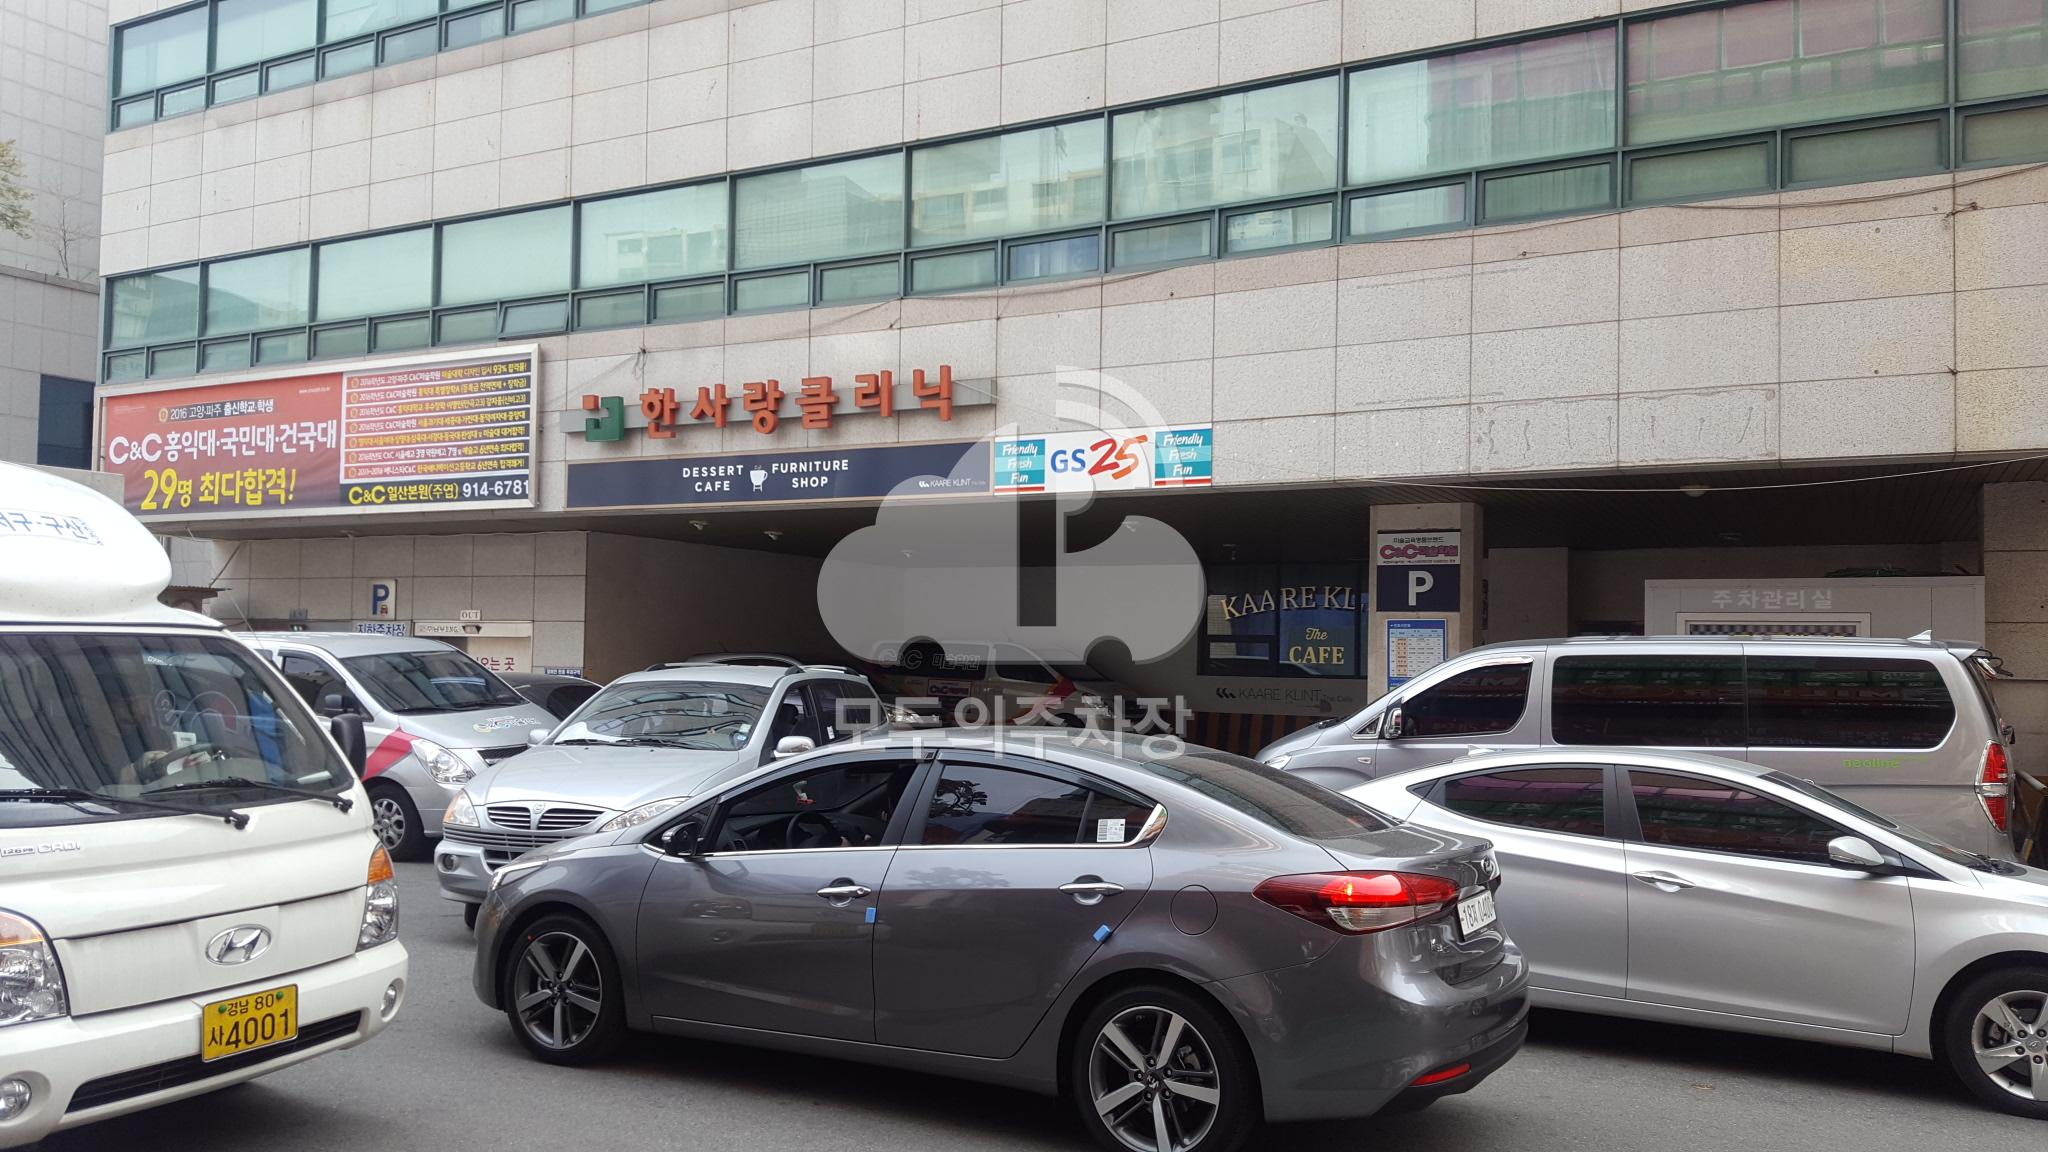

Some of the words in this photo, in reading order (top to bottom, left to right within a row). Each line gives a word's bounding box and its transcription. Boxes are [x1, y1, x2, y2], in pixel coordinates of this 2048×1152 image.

[639, 364, 953, 440] 한사랑클리닉
[169, 408, 188, 420] 2016
[1163, 433, 1204, 446] Friendly
[109, 434, 162, 465] C&C
[1002, 444, 1038, 456] Friendly
[1168, 449, 1198, 461] Fresh
[682, 465, 744, 478] DESSERT
[771, 459, 849, 474] FURNITURE
[1007, 457, 1033, 468] Fresh
[1173, 463, 1194, 476] Fun
[694, 481, 731, 492] CAFE
[791, 476, 829, 489] SHOP
[1010, 472, 1029, 484] Fun
[140, 468, 193, 510] 29명
[198, 467, 297, 505] 최다합격!
[348, 485, 386, 504] C&C
[387, 483, 459, 501] 일산본원(주엽)
[462, 480, 529, 498] 914-6781
[1408, 570, 1434, 606] P
[372, 584, 390, 615] P
[1220, 586, 1318, 621] KAARE
[1712, 590, 1832, 610] 주차관리실
[357, 623, 406, 637] 지하주차장
[1306, 627, 1328, 641] The
[1289, 645, 1344, 664] CAFE
[504, 657, 515, 671] 곳
[1239, 688, 1280, 700] KAARE
[228, 999, 249, 1016] 경남
[255, 993, 274, 1010] 80
[208, 1008, 289, 1048] 사4001
